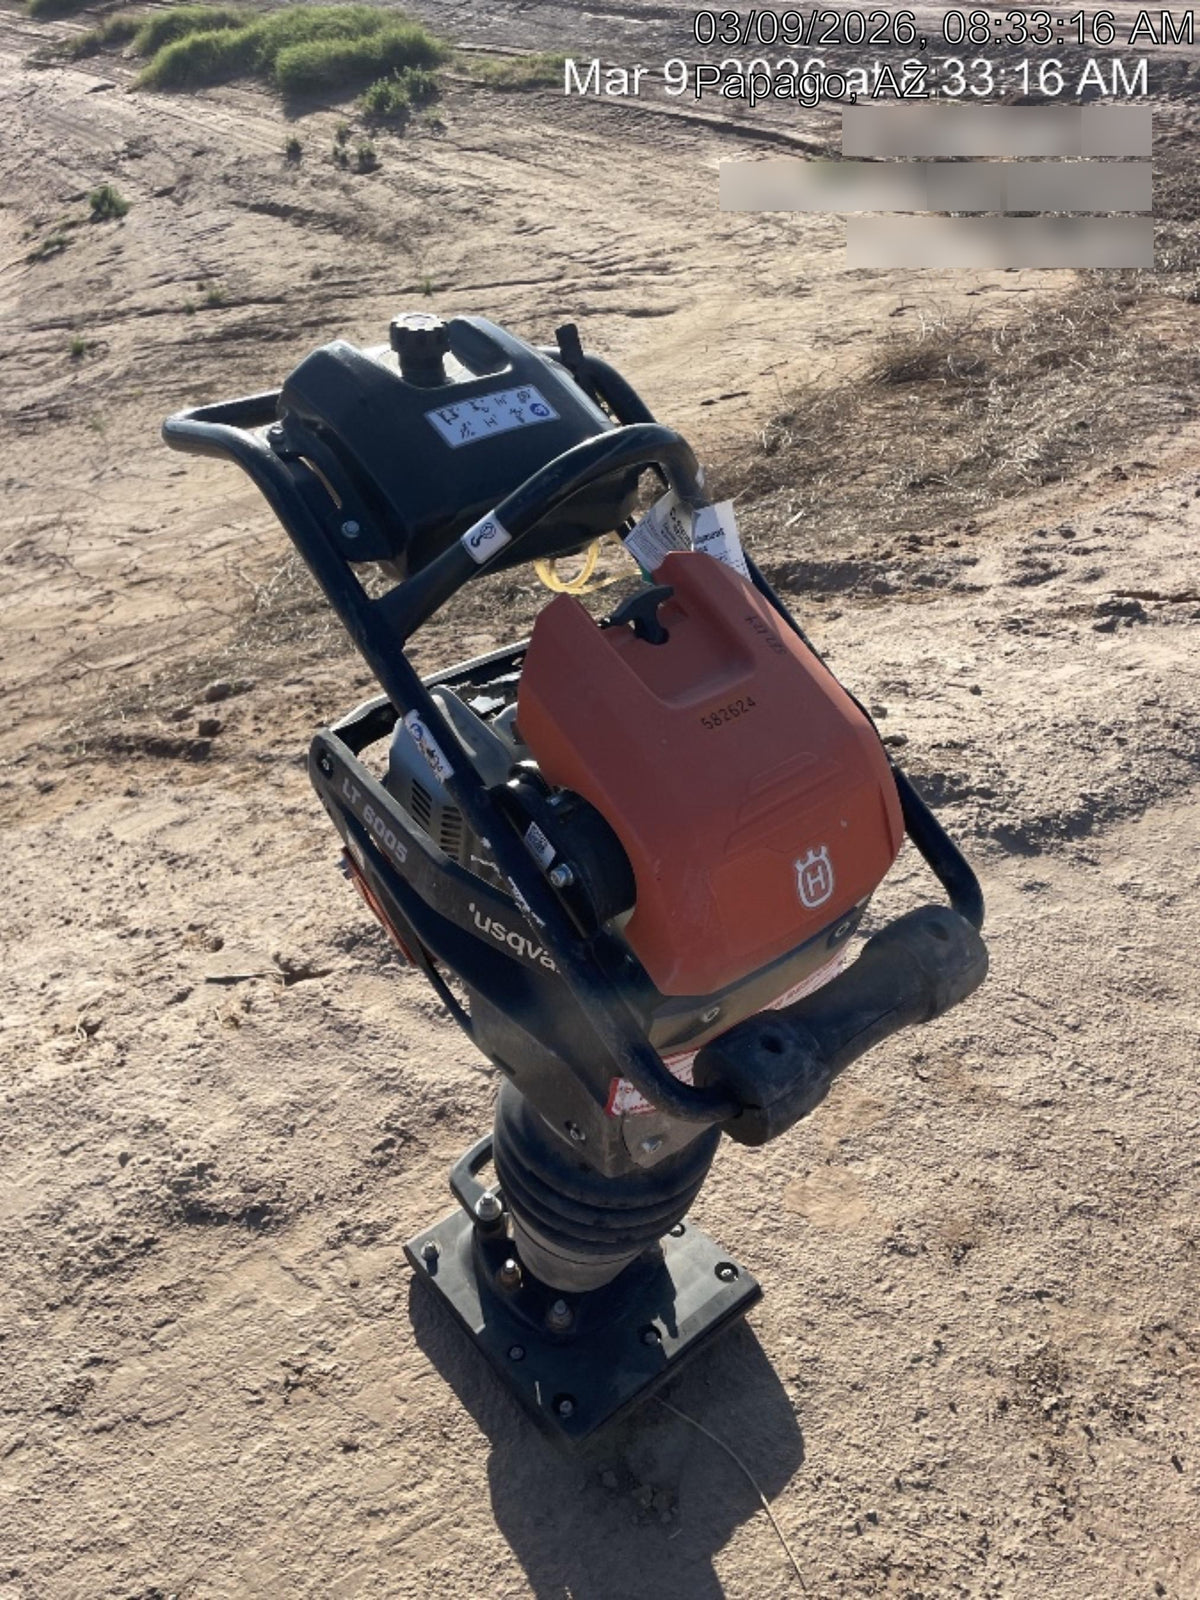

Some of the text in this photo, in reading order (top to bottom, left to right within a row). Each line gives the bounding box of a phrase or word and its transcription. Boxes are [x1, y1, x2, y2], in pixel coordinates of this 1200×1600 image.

[701, 696, 757, 731] 582624
[342, 777, 409, 864] LT 6005
